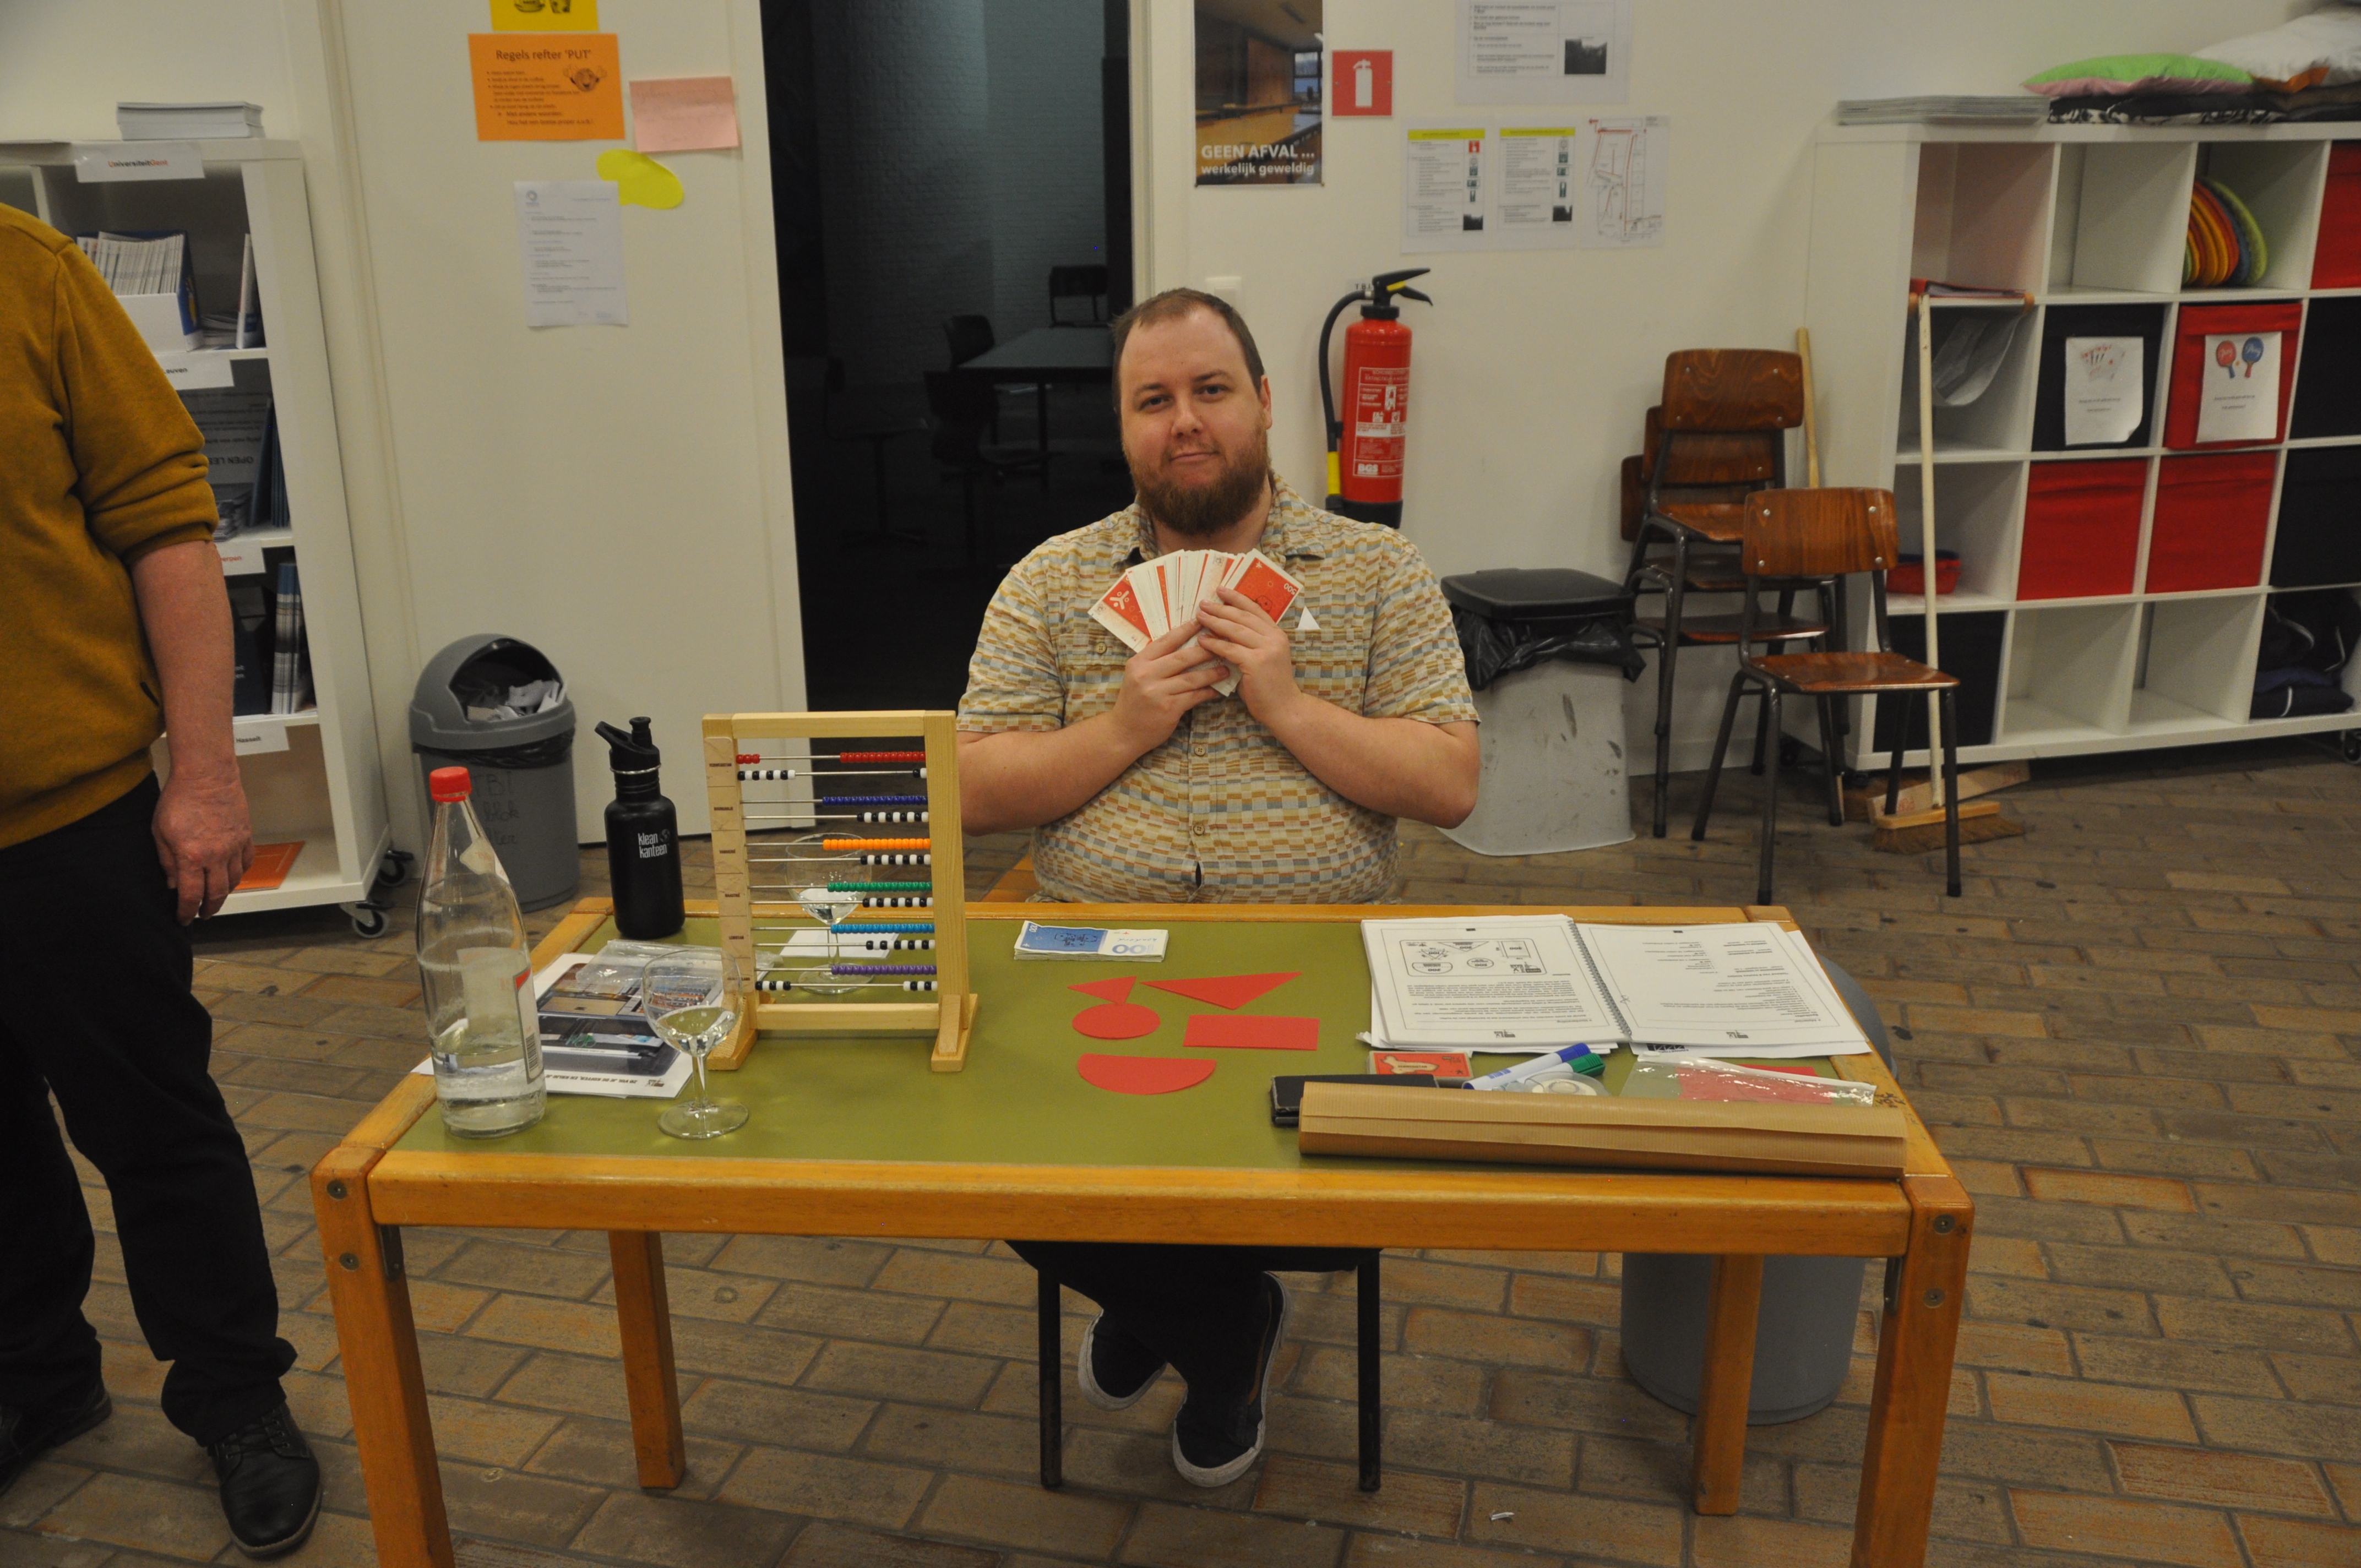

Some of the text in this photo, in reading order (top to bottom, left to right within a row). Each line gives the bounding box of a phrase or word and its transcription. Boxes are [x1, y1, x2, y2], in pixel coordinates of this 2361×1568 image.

[496, 50, 529, 62] Regels
[532, 49, 562, 59] refter
[1201, 144, 1245, 159] GEEN
[1248, 144, 1298, 159] AFVAL
[1201, 162, 1315, 176] werkelijk geweldig
[1283, 582, 1297, 596] 500
[638, 833, 658, 846] klean
[639, 843, 667, 858] kanteen
[1029, 924, 1038, 933] 100
[1112, 944, 1154, 954] 100
